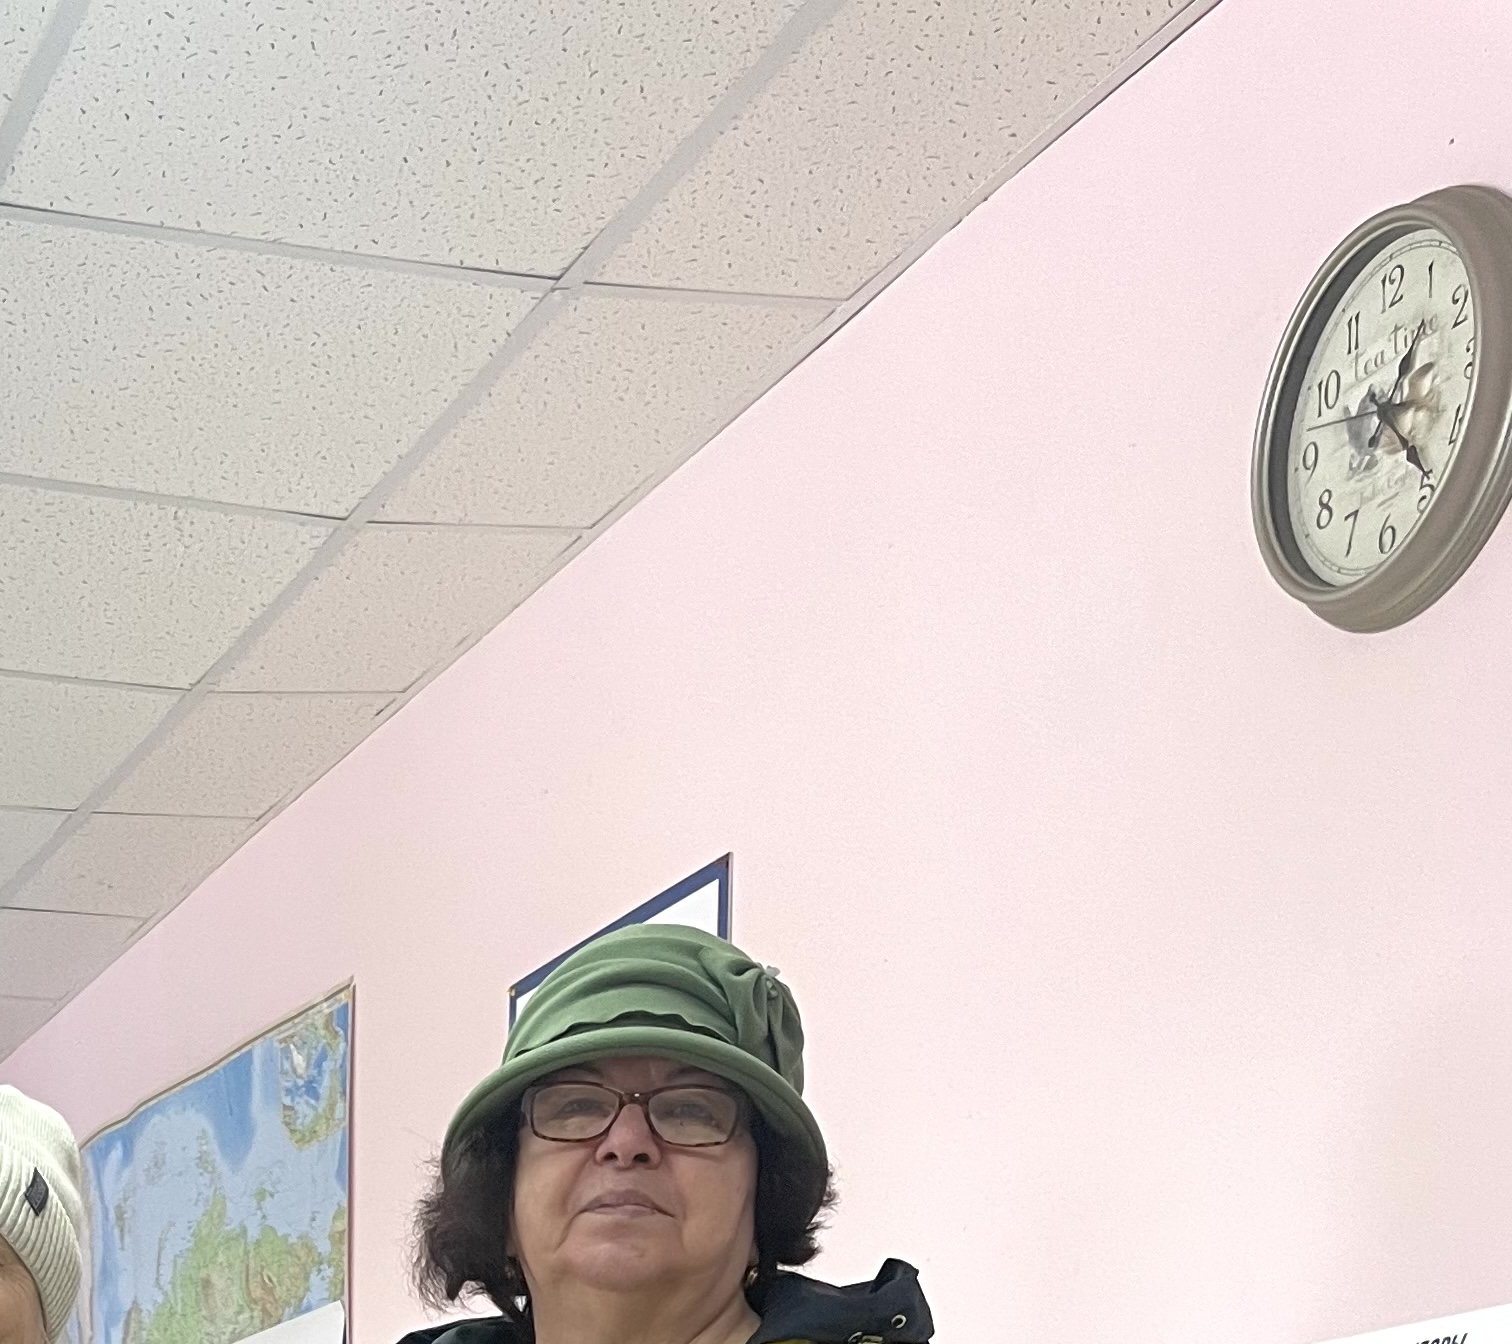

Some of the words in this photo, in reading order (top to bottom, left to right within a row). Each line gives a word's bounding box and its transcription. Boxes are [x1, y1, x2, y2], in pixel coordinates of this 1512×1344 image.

[1380, 264, 1405, 314] 12
[1428, 260, 1434, 298] 1
[1451, 284, 1469, 330] 2
[1347, 311, 1360, 355] 11
[1317, 370, 1340, 418] 10
[1302, 441, 1319, 487] 9
[1316, 489, 1333, 530] 8
[1344, 509, 1359, 558] 7
[1378, 512, 1396, 554] 6
